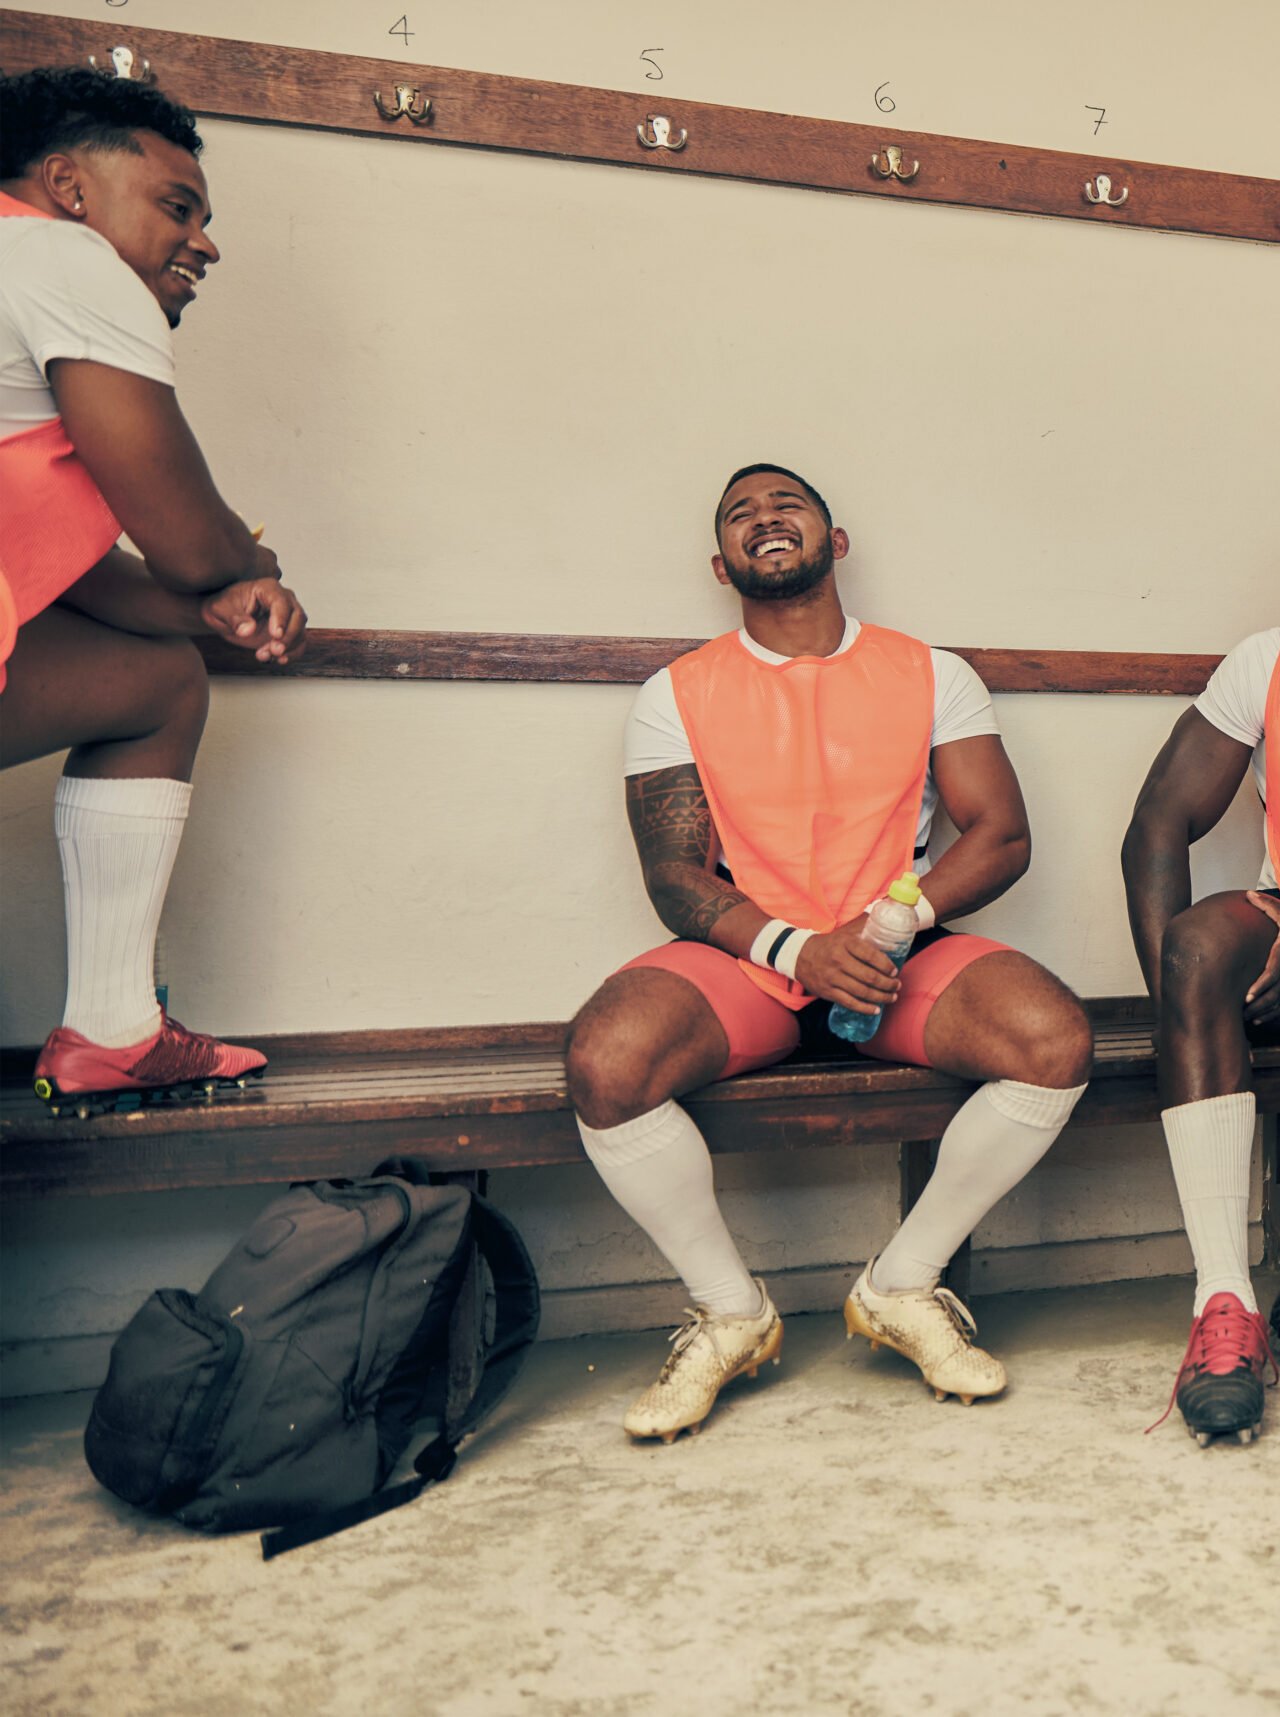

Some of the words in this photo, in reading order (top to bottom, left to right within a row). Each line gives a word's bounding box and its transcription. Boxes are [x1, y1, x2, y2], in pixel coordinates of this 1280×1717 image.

[387, 14, 416, 47] 4
[639, 47, 665, 81] 5
[873, 81, 898, 114] 6
[1084, 104, 1109, 136] 7
